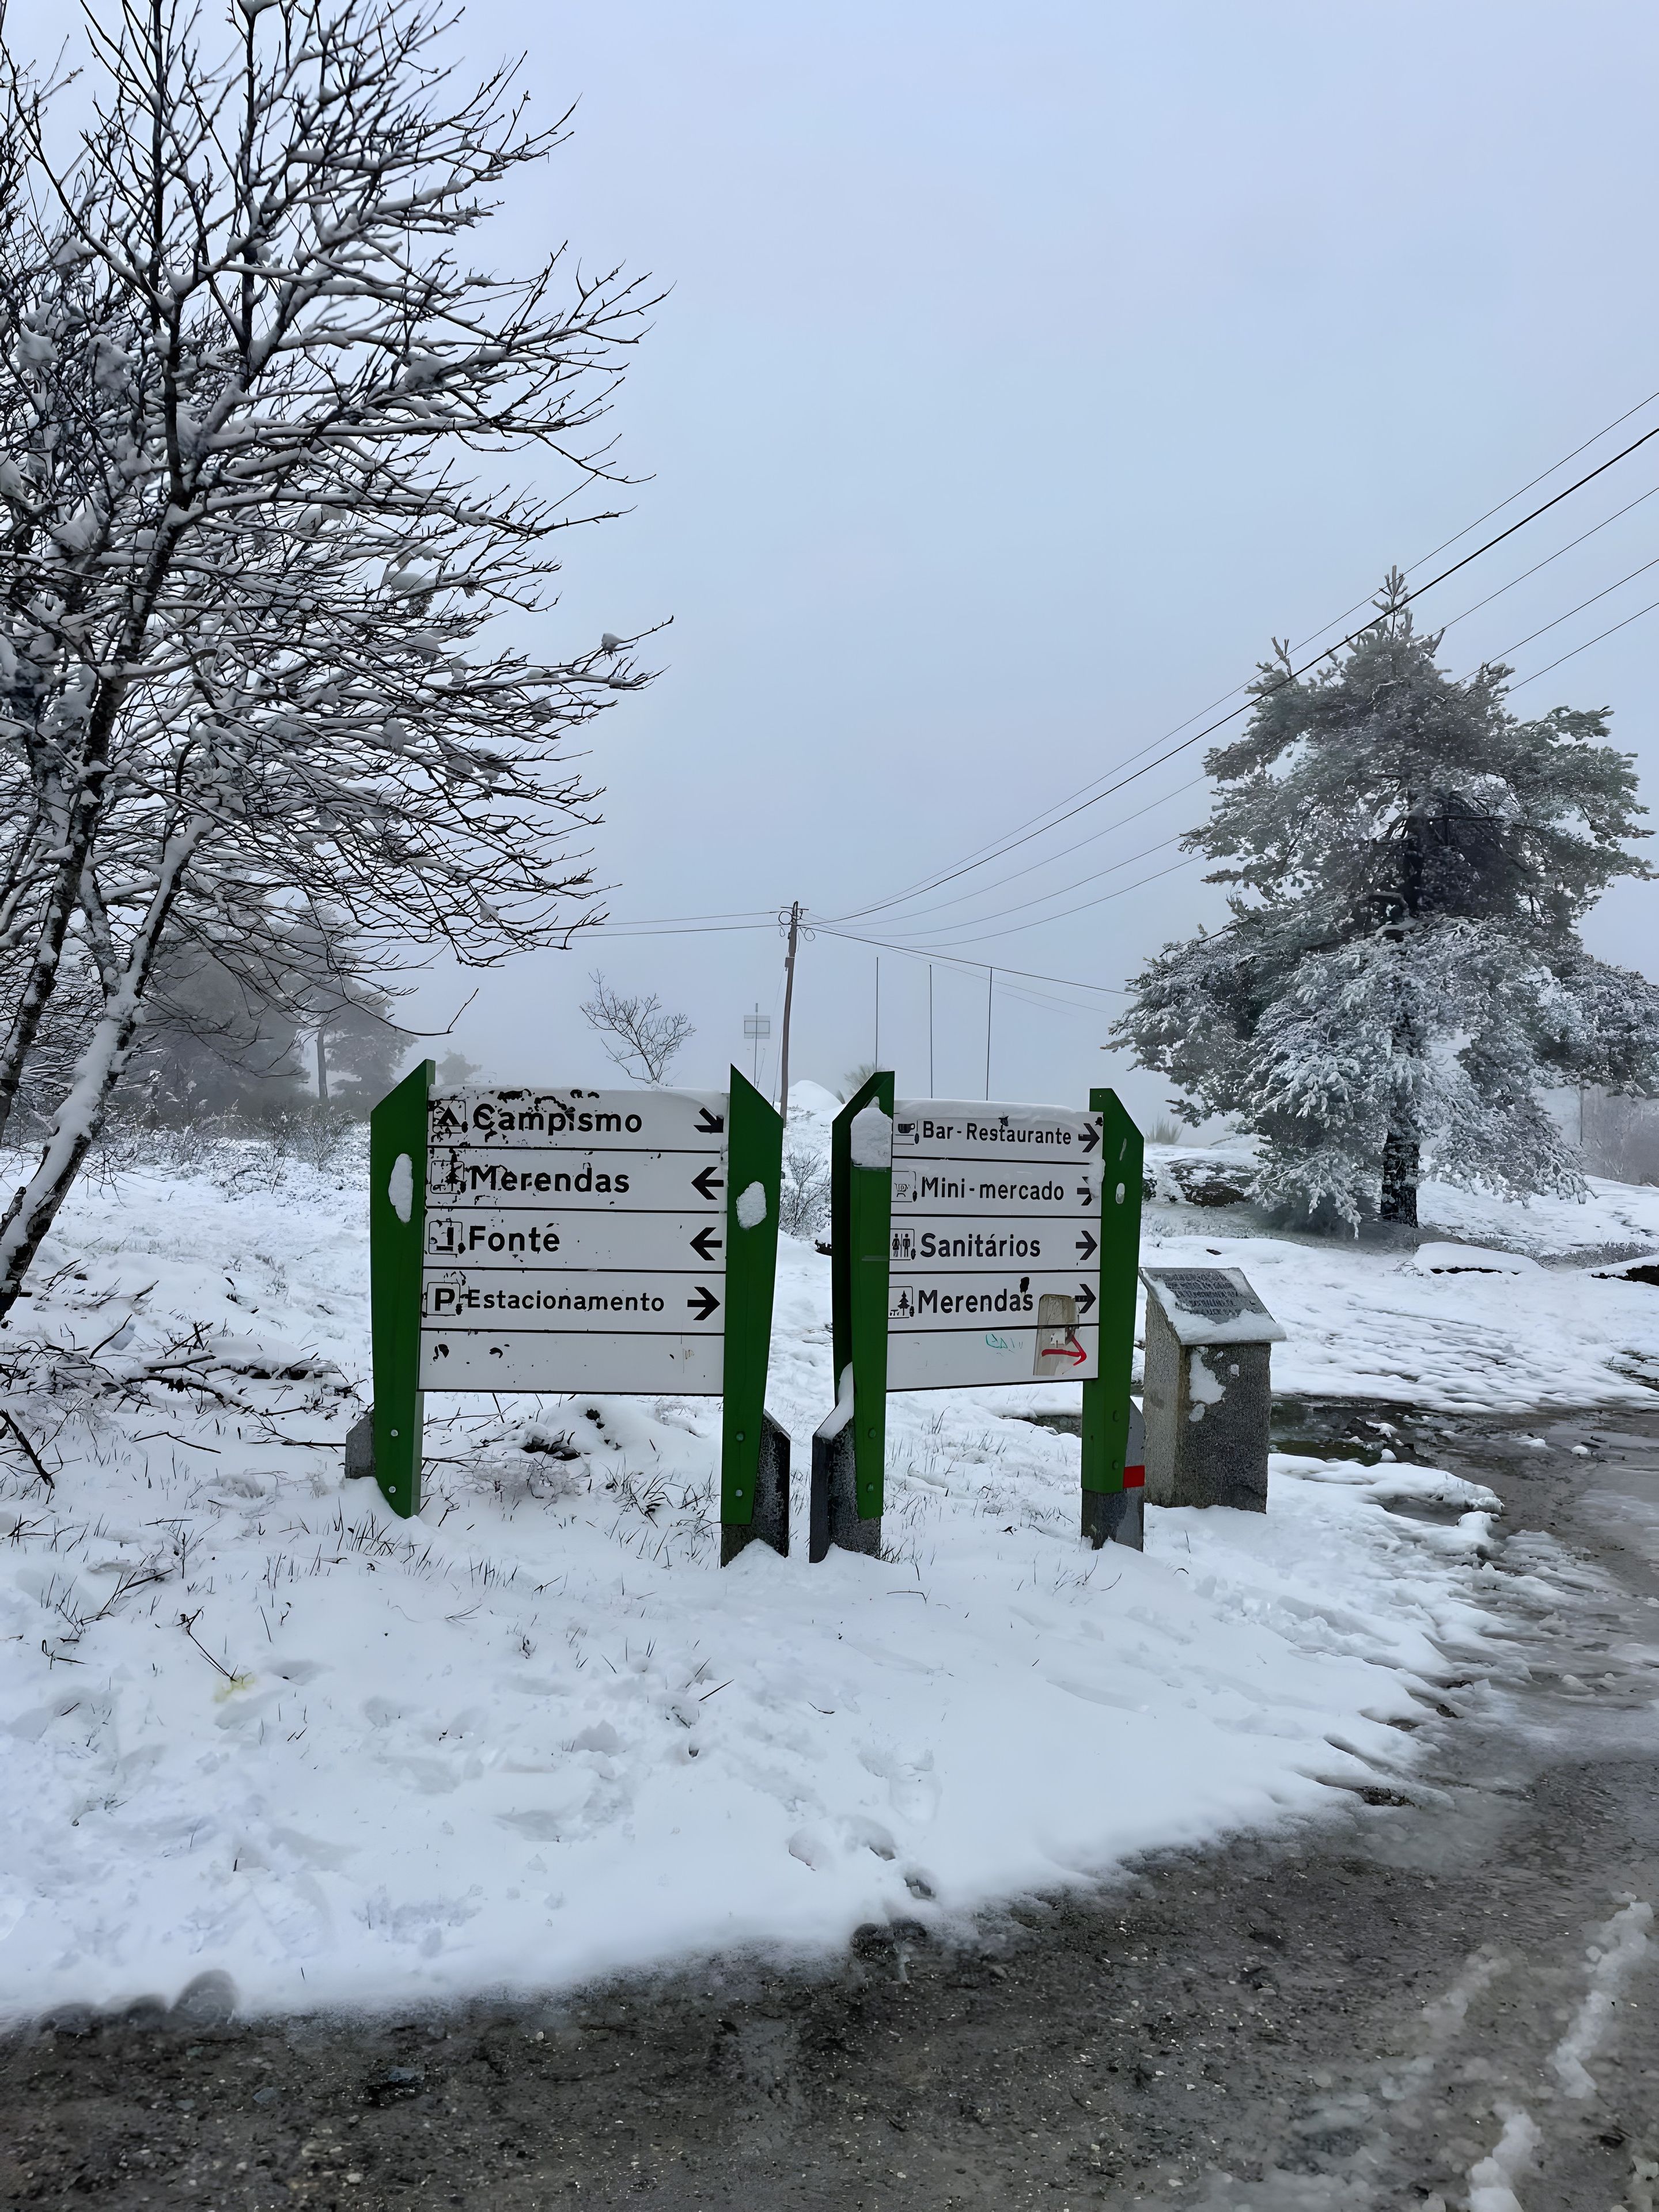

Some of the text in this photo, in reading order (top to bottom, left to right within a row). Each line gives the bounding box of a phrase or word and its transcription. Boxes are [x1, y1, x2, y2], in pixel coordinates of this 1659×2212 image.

[471, 1165, 630, 1193] Merendas
[919, 1233, 1041, 1258] Sanitários
[434, 1287, 665, 1312] P Estacionamento
[918, 1288, 1034, 1314] Merendas
